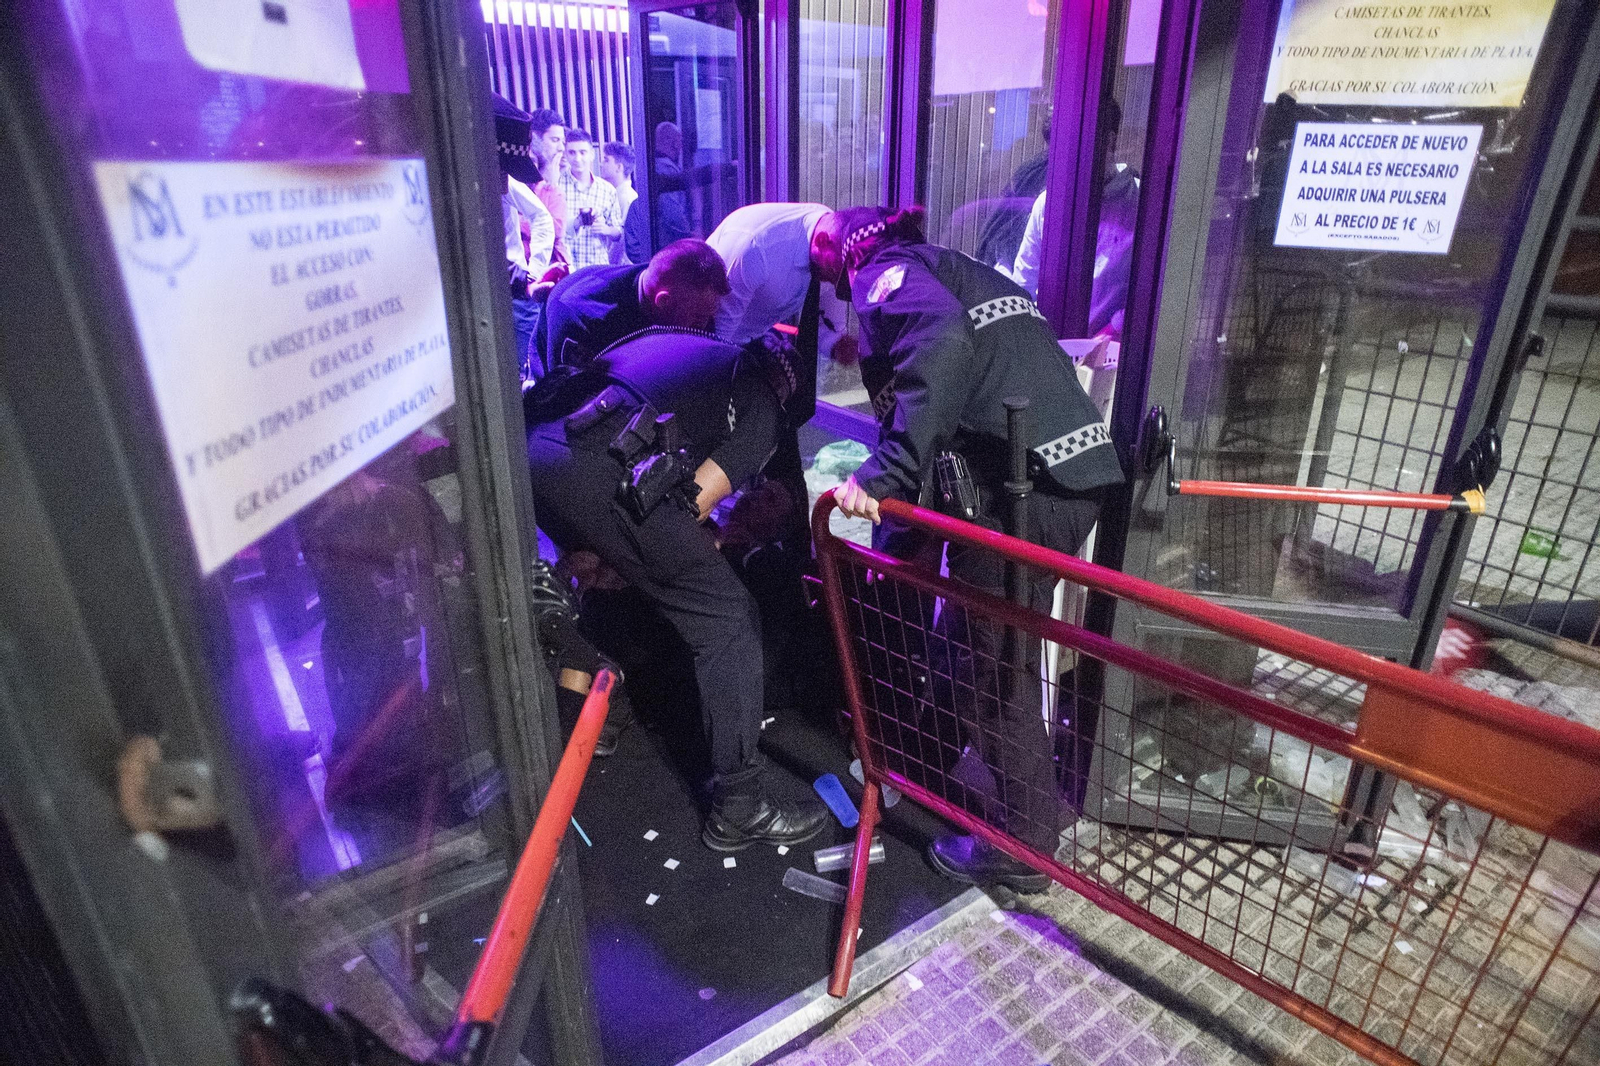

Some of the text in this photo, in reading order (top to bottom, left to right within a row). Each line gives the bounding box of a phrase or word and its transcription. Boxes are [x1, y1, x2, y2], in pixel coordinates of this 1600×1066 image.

[1335, 5, 1405, 19] CAMISETAS
[1407, 5, 1425, 18] DE
[1374, 26, 1440, 39] CHANCLAS
[1277, 45, 1285, 58] Y
[1287, 45, 1319, 58] TODO
[1321, 45, 1350, 58] TIPO
[1351, 45, 1370, 58] DE
[1371, 45, 1468, 59] INDUMENTARIA
[1471, 45, 1489, 58] DE
[1289, 79, 1343, 93] GRACIAS
[1345, 80, 1371, 93] POR
[1372, 80, 1391, 94] SU
[1303, 132, 1469, 151] PARA ACCEDER DE NUEVO
[1299, 159, 1459, 179] A LA SALA ES NECESARIO
[203, 193, 228, 220] EN
[234, 190, 272, 216] ESTE
[1297, 186, 1447, 206] ADQUIRIR UNA PULSERA
[1314, 213, 1418, 231] AL PRECIO DE 1€
[250, 228, 273, 250] NO
[270, 262, 289, 287] EL
[248, 319, 331, 368] CAMISETAS
[333, 313, 350, 337] DE
[309, 335, 374, 379] CHANCLAS
[204, 424, 257, 467] TODO
[259, 405, 295, 440] TIPO
[296, 394, 315, 421] DE
[234, 461, 308, 522] GRACIAS
[310, 443, 338, 477] POR
